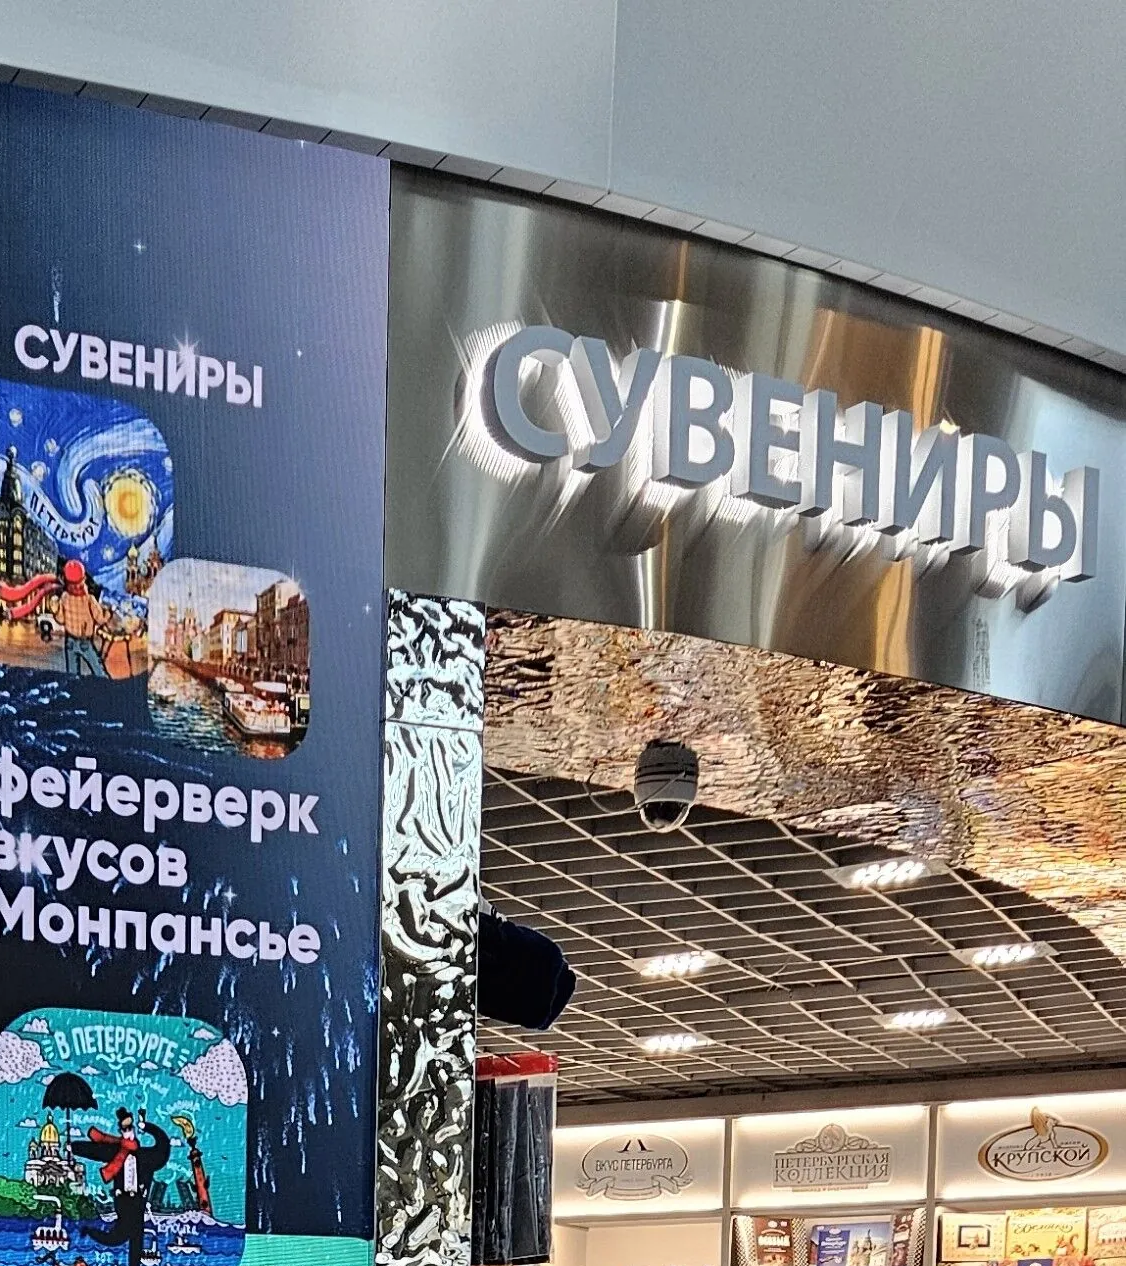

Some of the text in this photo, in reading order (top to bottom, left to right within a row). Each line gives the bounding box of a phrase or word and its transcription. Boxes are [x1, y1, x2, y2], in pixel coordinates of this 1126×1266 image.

[14, 324, 264, 408] СУВЕНИРЫ
[482, 325, 1100, 583] СУВЕНИРЫ
[54, 1025, 178, 1068] В ПЕТЕРБУРГЕ
[595, 1157, 673, 1172] ВКУС ПЕТЕРБУРГА
[775, 1152, 890, 1169] ПЕТЕРБУРГСКАЯ
[993, 1143, 1091, 1172] КРУПСКОЙ
[775, 1164, 889, 1184] КОЛЛЕКЦИЯ
